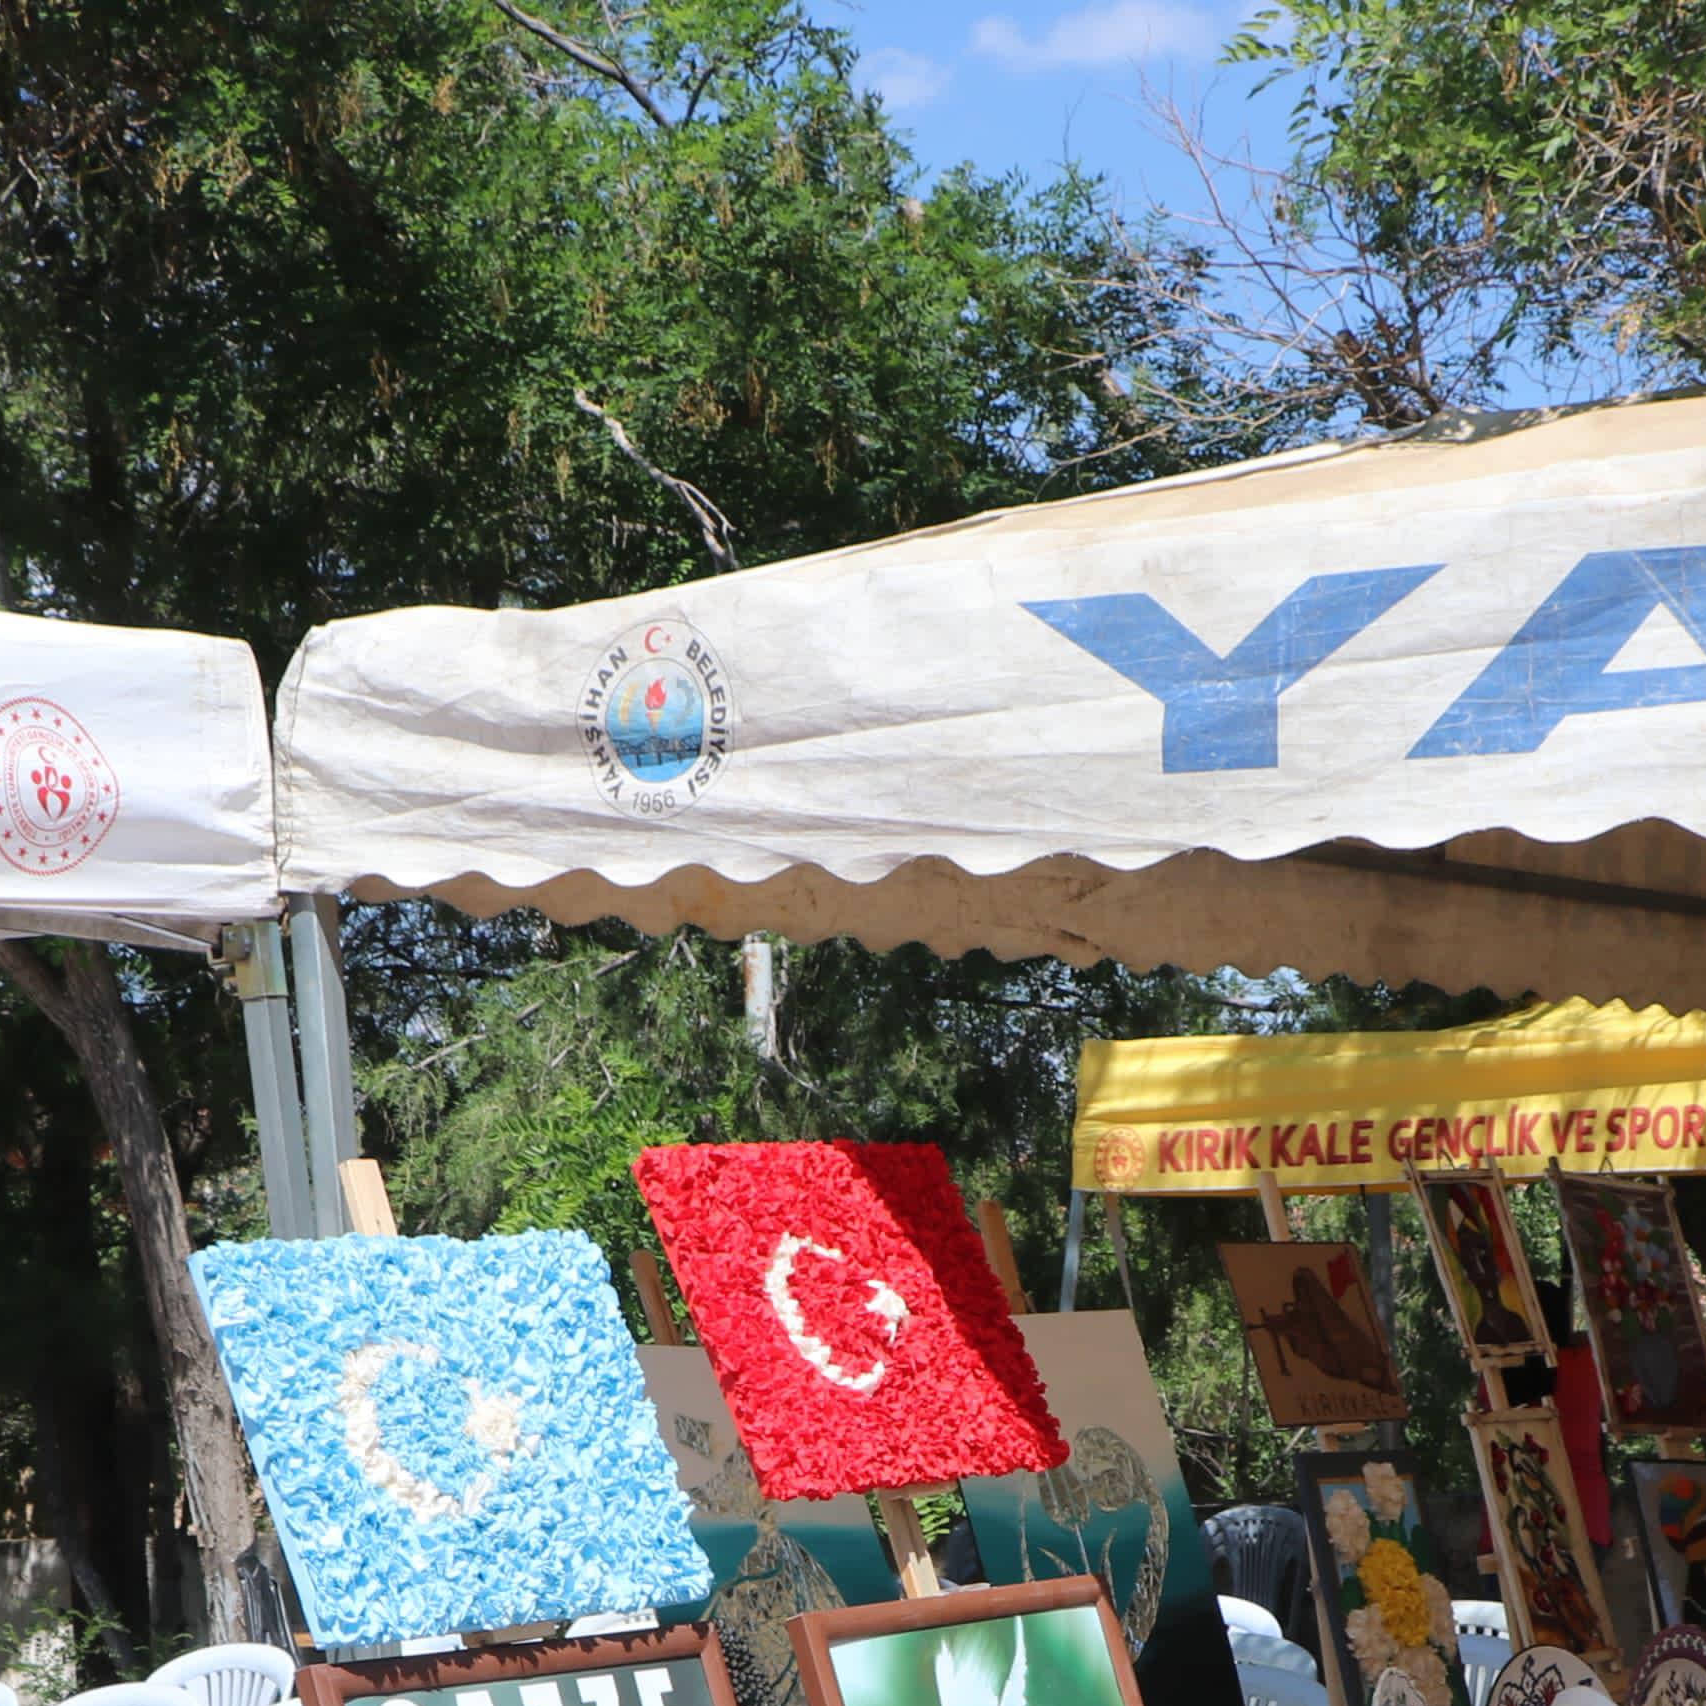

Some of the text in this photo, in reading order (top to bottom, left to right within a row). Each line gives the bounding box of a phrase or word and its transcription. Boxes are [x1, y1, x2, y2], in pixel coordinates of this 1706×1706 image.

[632, 789, 676, 814] 1956
[1156, 1124, 1262, 1174] KIRIK
[1270, 1119, 1374, 1167] KALE
[1388, 1103, 1543, 1170] GENÇLİK
[1550, 1109, 1594, 1155] VE
[1605, 1103, 1706, 1152] SPOR
